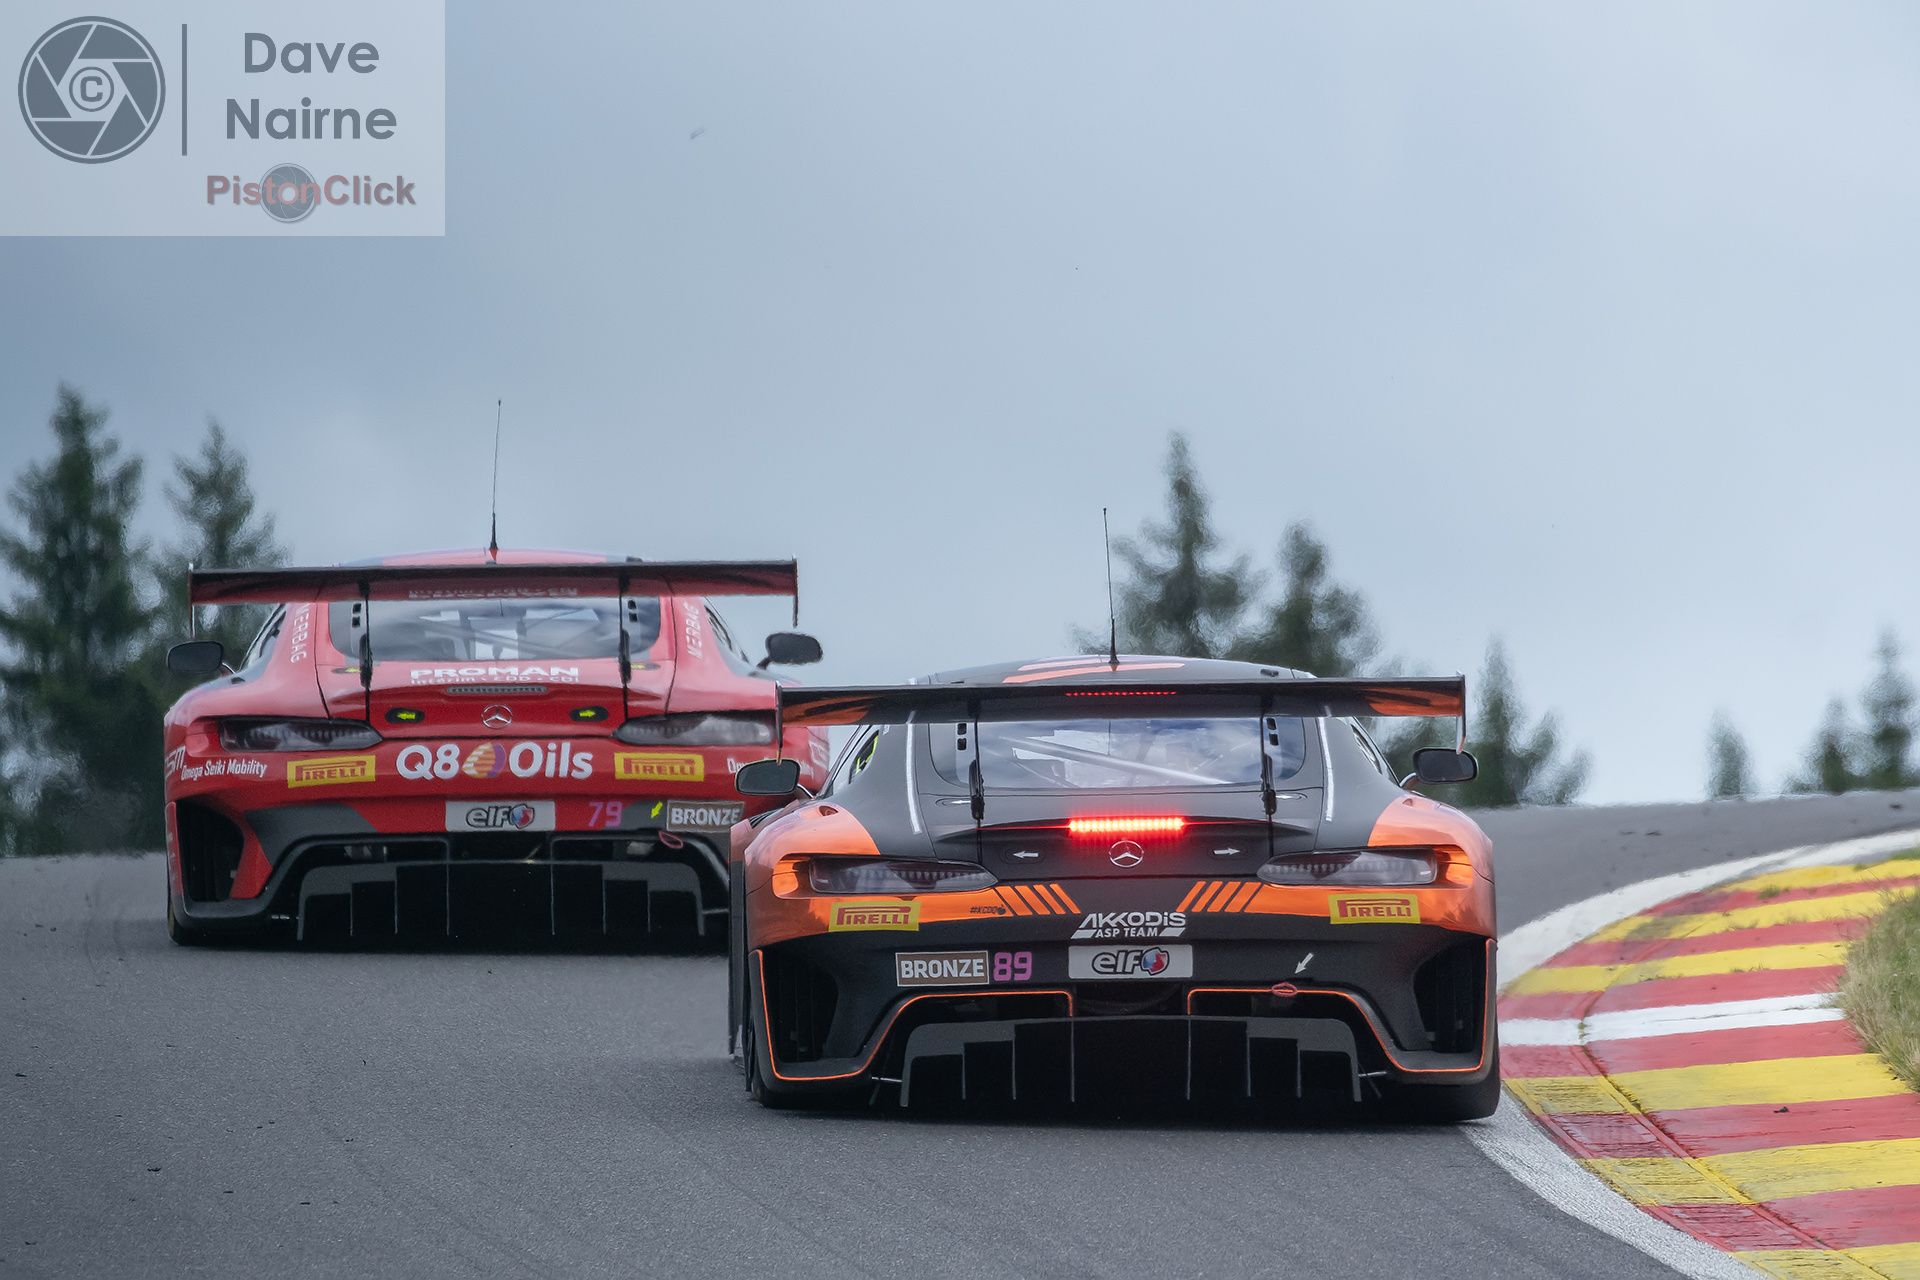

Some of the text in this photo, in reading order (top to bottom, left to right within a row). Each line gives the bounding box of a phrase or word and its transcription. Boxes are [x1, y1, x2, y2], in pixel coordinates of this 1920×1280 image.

[410, 666, 579, 679] PROMAN
[204, 759, 226, 776] Seiki
[226, 758, 268, 778] Mobility
[294, 760, 368, 782] PIRELLI
[395, 741, 593, 780] Q8 Oils
[622, 758, 696, 776] PIRELLI
[465, 805, 510, 828] elf
[588, 801, 623, 828] 79
[670, 808, 740, 826] BRONZE
[836, 906, 912, 926] PIRELLI
[1336, 898, 1412, 918] PIRELLI
[1095, 927, 1158, 938] ASP TEAM
[900, 957, 985, 979] BRONZE
[993, 951, 1033, 982] 89
[1091, 949, 1142, 975] elf
